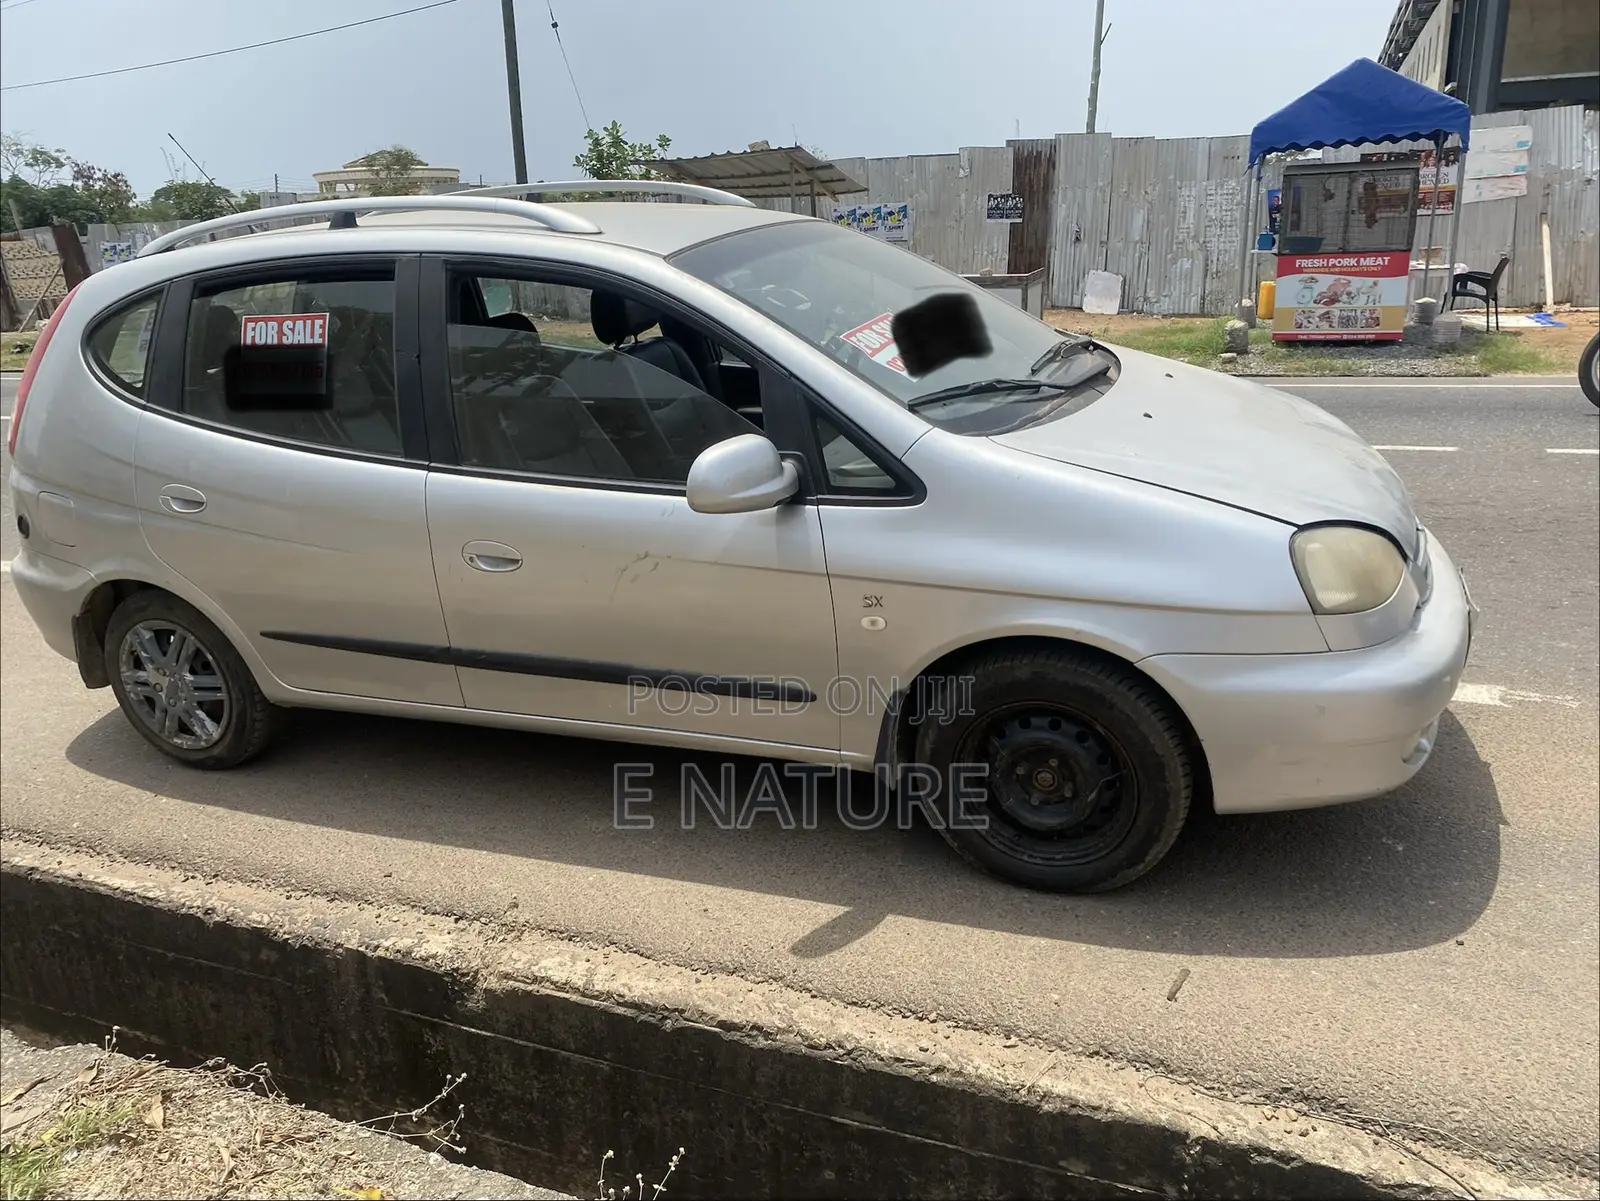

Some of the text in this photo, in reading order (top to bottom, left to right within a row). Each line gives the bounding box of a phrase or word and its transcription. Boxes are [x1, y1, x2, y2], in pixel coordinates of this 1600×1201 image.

[1295, 257, 1390, 268] FRESH PORK MEAT
[245, 320, 323, 346] FOR SALE
[849, 329, 888, 355] FOR
[863, 593, 884, 608] SX
